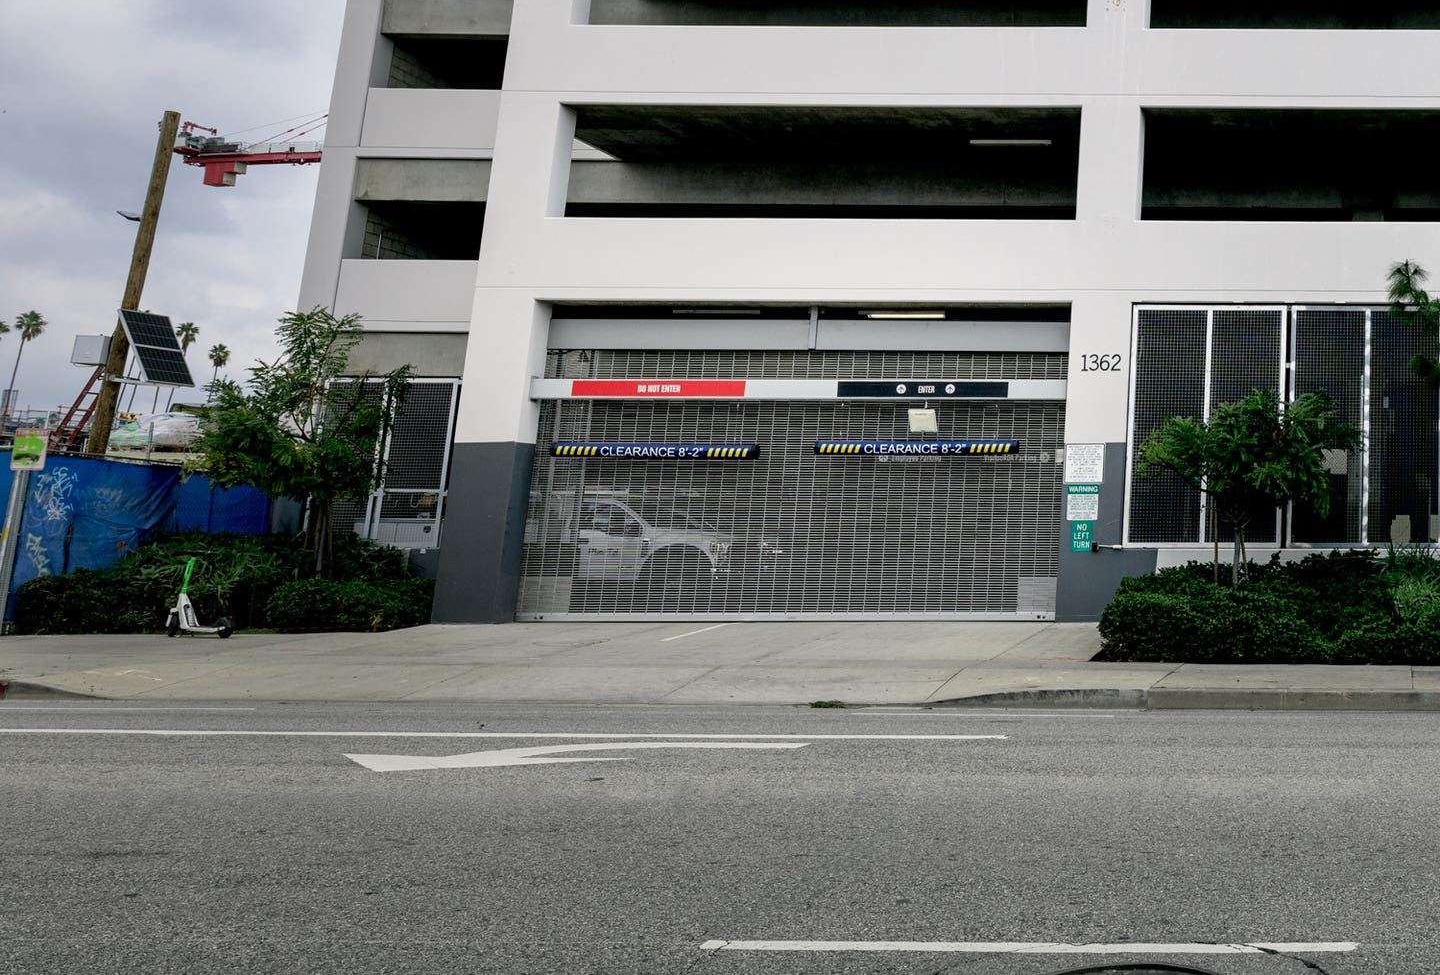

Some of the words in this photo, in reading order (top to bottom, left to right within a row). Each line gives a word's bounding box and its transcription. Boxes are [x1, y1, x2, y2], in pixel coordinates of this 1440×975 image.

[1081, 354, 1122, 371] 1362
[637, 384, 647, 393] DO
[647, 384, 660, 393] NOT
[661, 384, 681, 393] ENTER
[918, 385, 935, 394] ENTER
[600, 446, 675, 457] CLEARANCE
[864, 443, 938, 454] CLEARANCE
[1068, 485, 1099, 493] WARNING
[1073, 532, 1089, 540] LEFT
